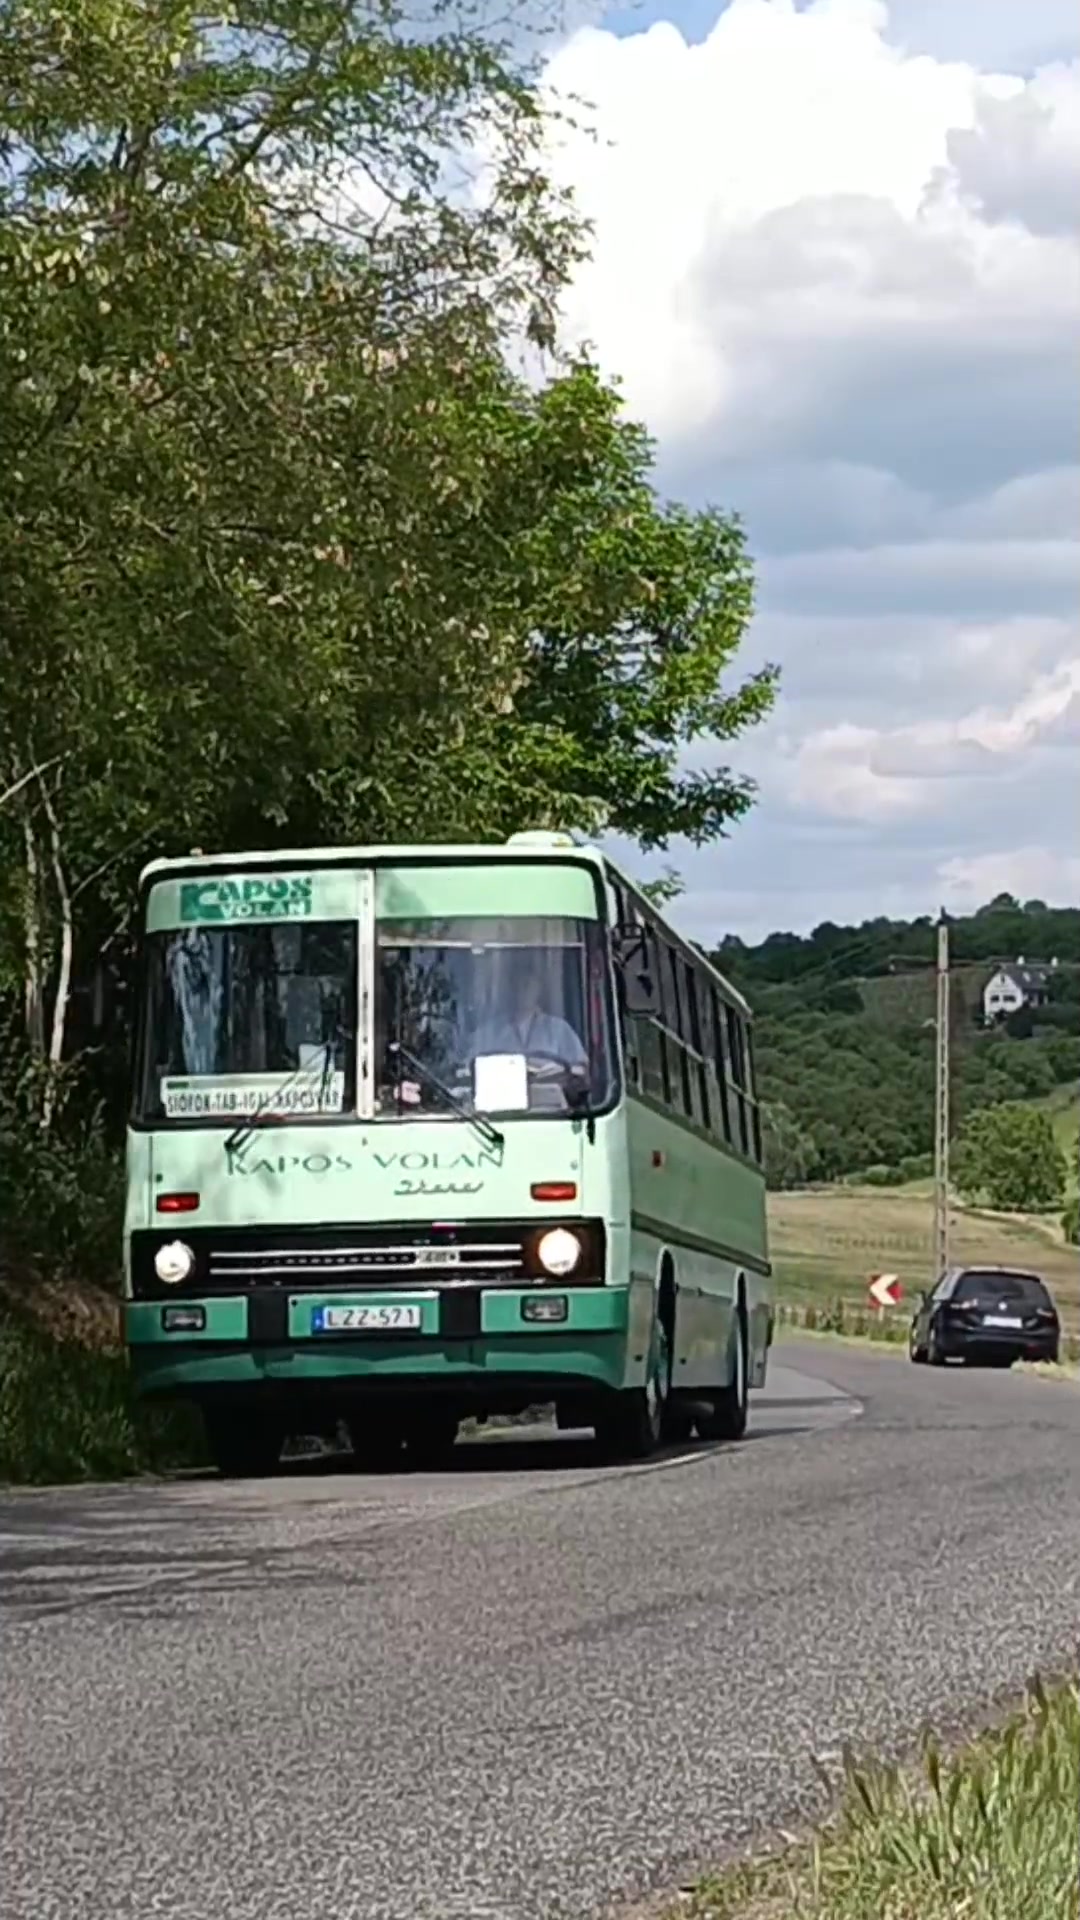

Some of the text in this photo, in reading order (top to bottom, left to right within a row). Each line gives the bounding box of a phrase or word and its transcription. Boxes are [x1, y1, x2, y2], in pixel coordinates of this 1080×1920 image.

[180, 878, 313, 921] KAPOS
[227, 1151, 352, 1176] KAPOS
[327, 1308, 414, 1326] LZZ-571
